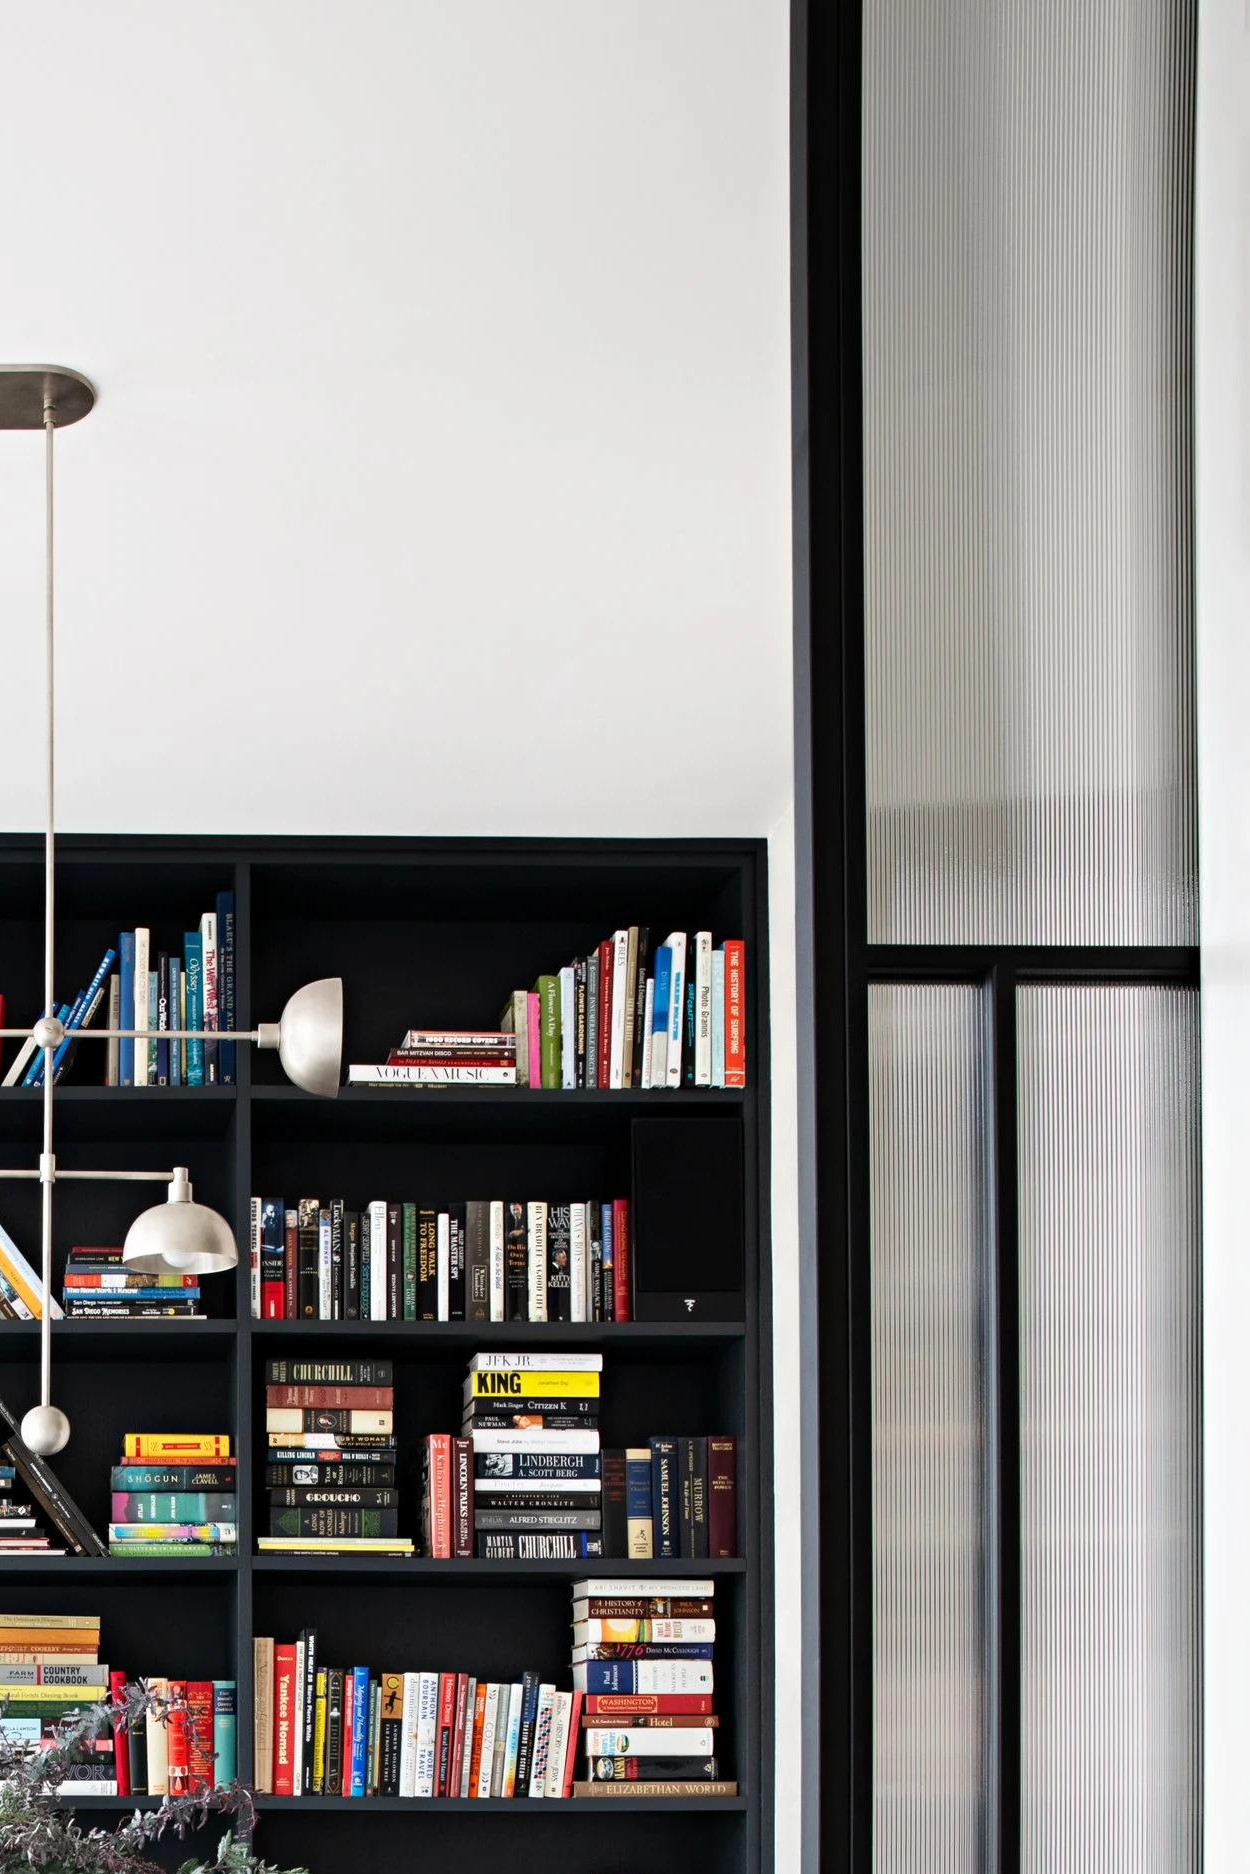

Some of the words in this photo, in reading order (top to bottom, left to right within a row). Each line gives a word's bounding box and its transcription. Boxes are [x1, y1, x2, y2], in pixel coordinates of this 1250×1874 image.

[206, 950, 215, 967] The
[618, 947, 626, 966] BEES
[730, 951, 739, 967] THE
[186, 958, 199, 993] Odyssey
[204, 968, 215, 986] Way
[660, 971, 668, 990] bliss
[730, 969, 739, 1004] HISTORY
[206, 988, 215, 1010] West
[548, 989, 556, 1014] Flower
[701, 986, 709, 1008] Photo:
[730, 1006, 739, 1017] OF
[546, 1023, 555, 1037] Day
[701, 1011, 709, 1038] Grannis
[730, 1019, 739, 1054] SURFING
[376, 1067, 427, 1079] VOGUE
[431, 1068, 438, 1079] X
[442, 1068, 489, 1080] MUSIC
[420, 1223, 427, 1234] TO
[293, 1364, 353, 1381] CHURCHILL
[477, 1373, 521, 1394] KING
[518, 1456, 584, 1467] LINDBERGH
[459, 1453, 468, 1490] LINCOLN
[518, 1469, 526, 1477] A.
[529, 1469, 554, 1477] SCOTT
[556, 1469, 578, 1478] BERG
[661, 1458, 669, 1495] SAMUEL
[306, 1494, 361, 1502] GROUCHO
[460, 1491, 468, 1517] TALKS
[694, 1478, 703, 1523] MURROW
[616, 1644, 646, 1656] 1776
[44, 1667, 80, 1675] COUNTRY
[44, 1676, 88, 1684] COOKBOOK
[280, 1675, 289, 1718] Yankee
[445, 1679, 453, 1702] Homo
[444, 1704, 452, 1722] Deus
[650, 1718, 672, 1726] Hotel
[279, 1721, 288, 1764] Nomad
[606, 1785, 681, 1794] ELIZABETHAN
[685, 1785, 726, 1794] WORLD
